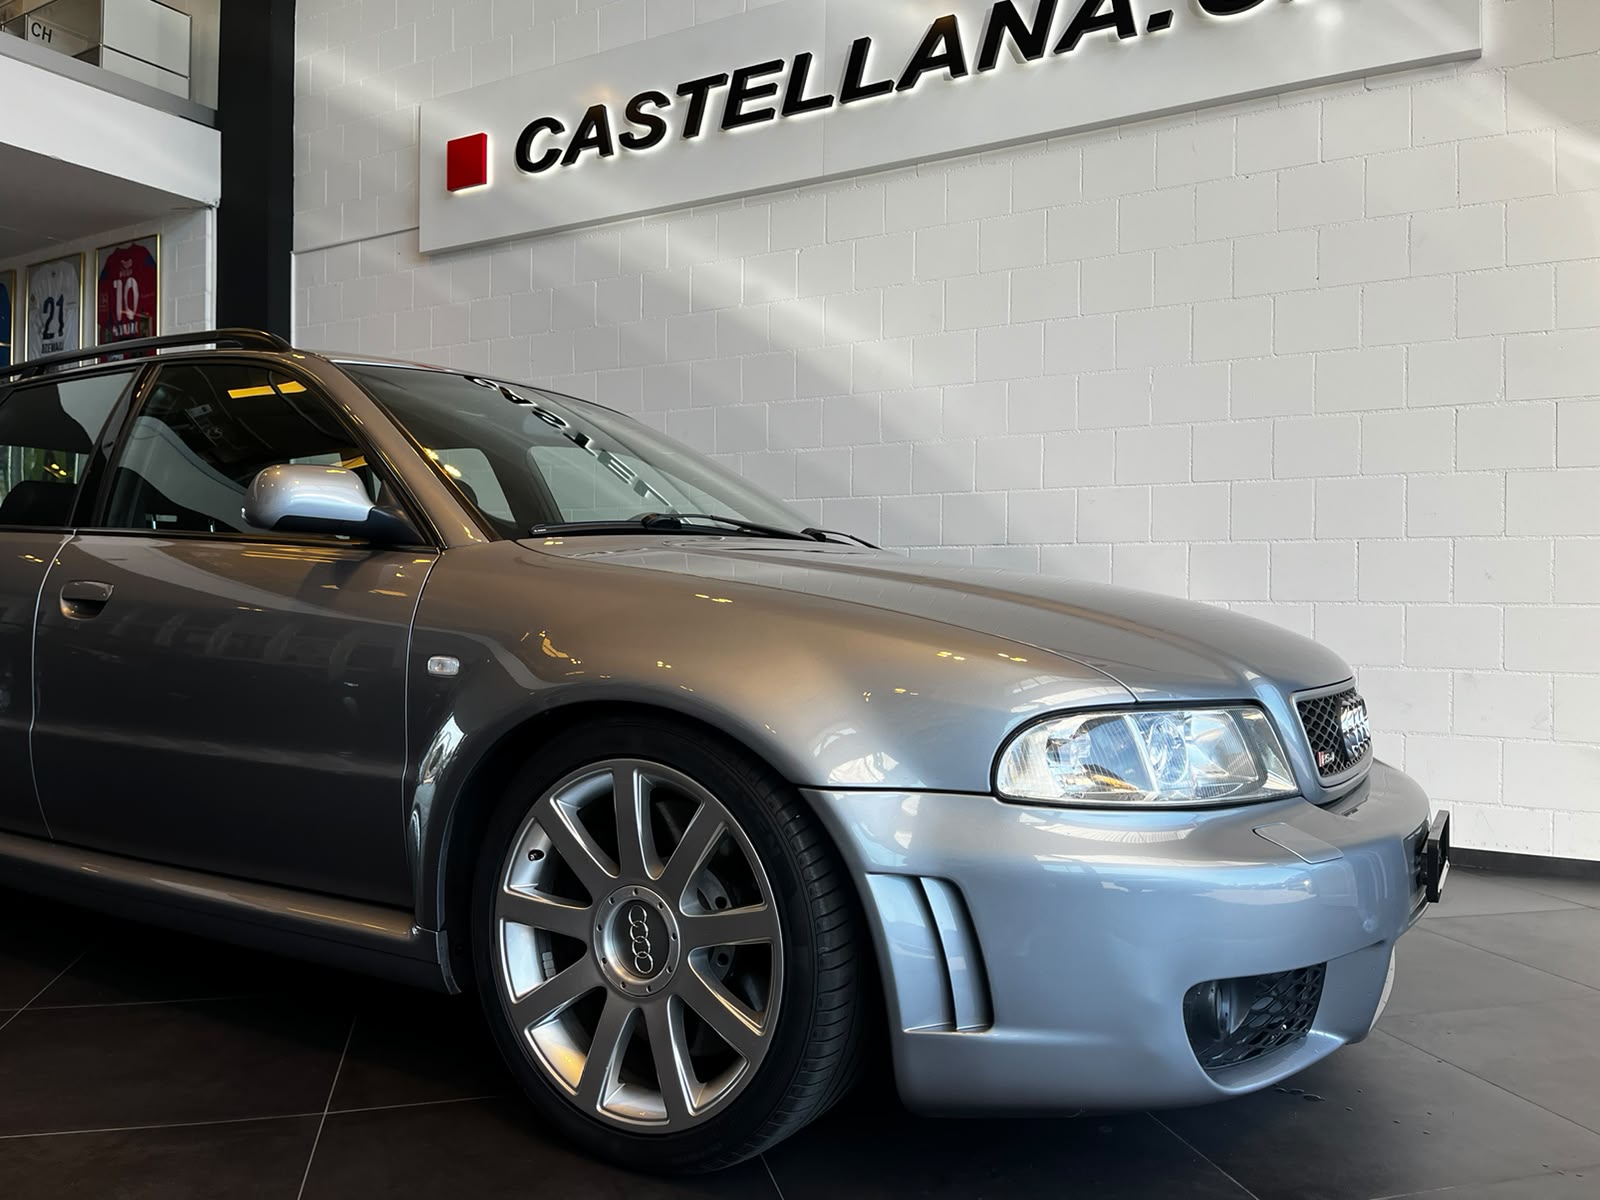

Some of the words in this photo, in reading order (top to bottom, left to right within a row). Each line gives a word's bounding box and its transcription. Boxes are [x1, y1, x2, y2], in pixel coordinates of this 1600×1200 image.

[31, 22, 52, 43] CH
[514, 0, 1264, 174] CASTELLANA.
[42, 294, 64, 340] 21
[113, 277, 139, 321] 10
